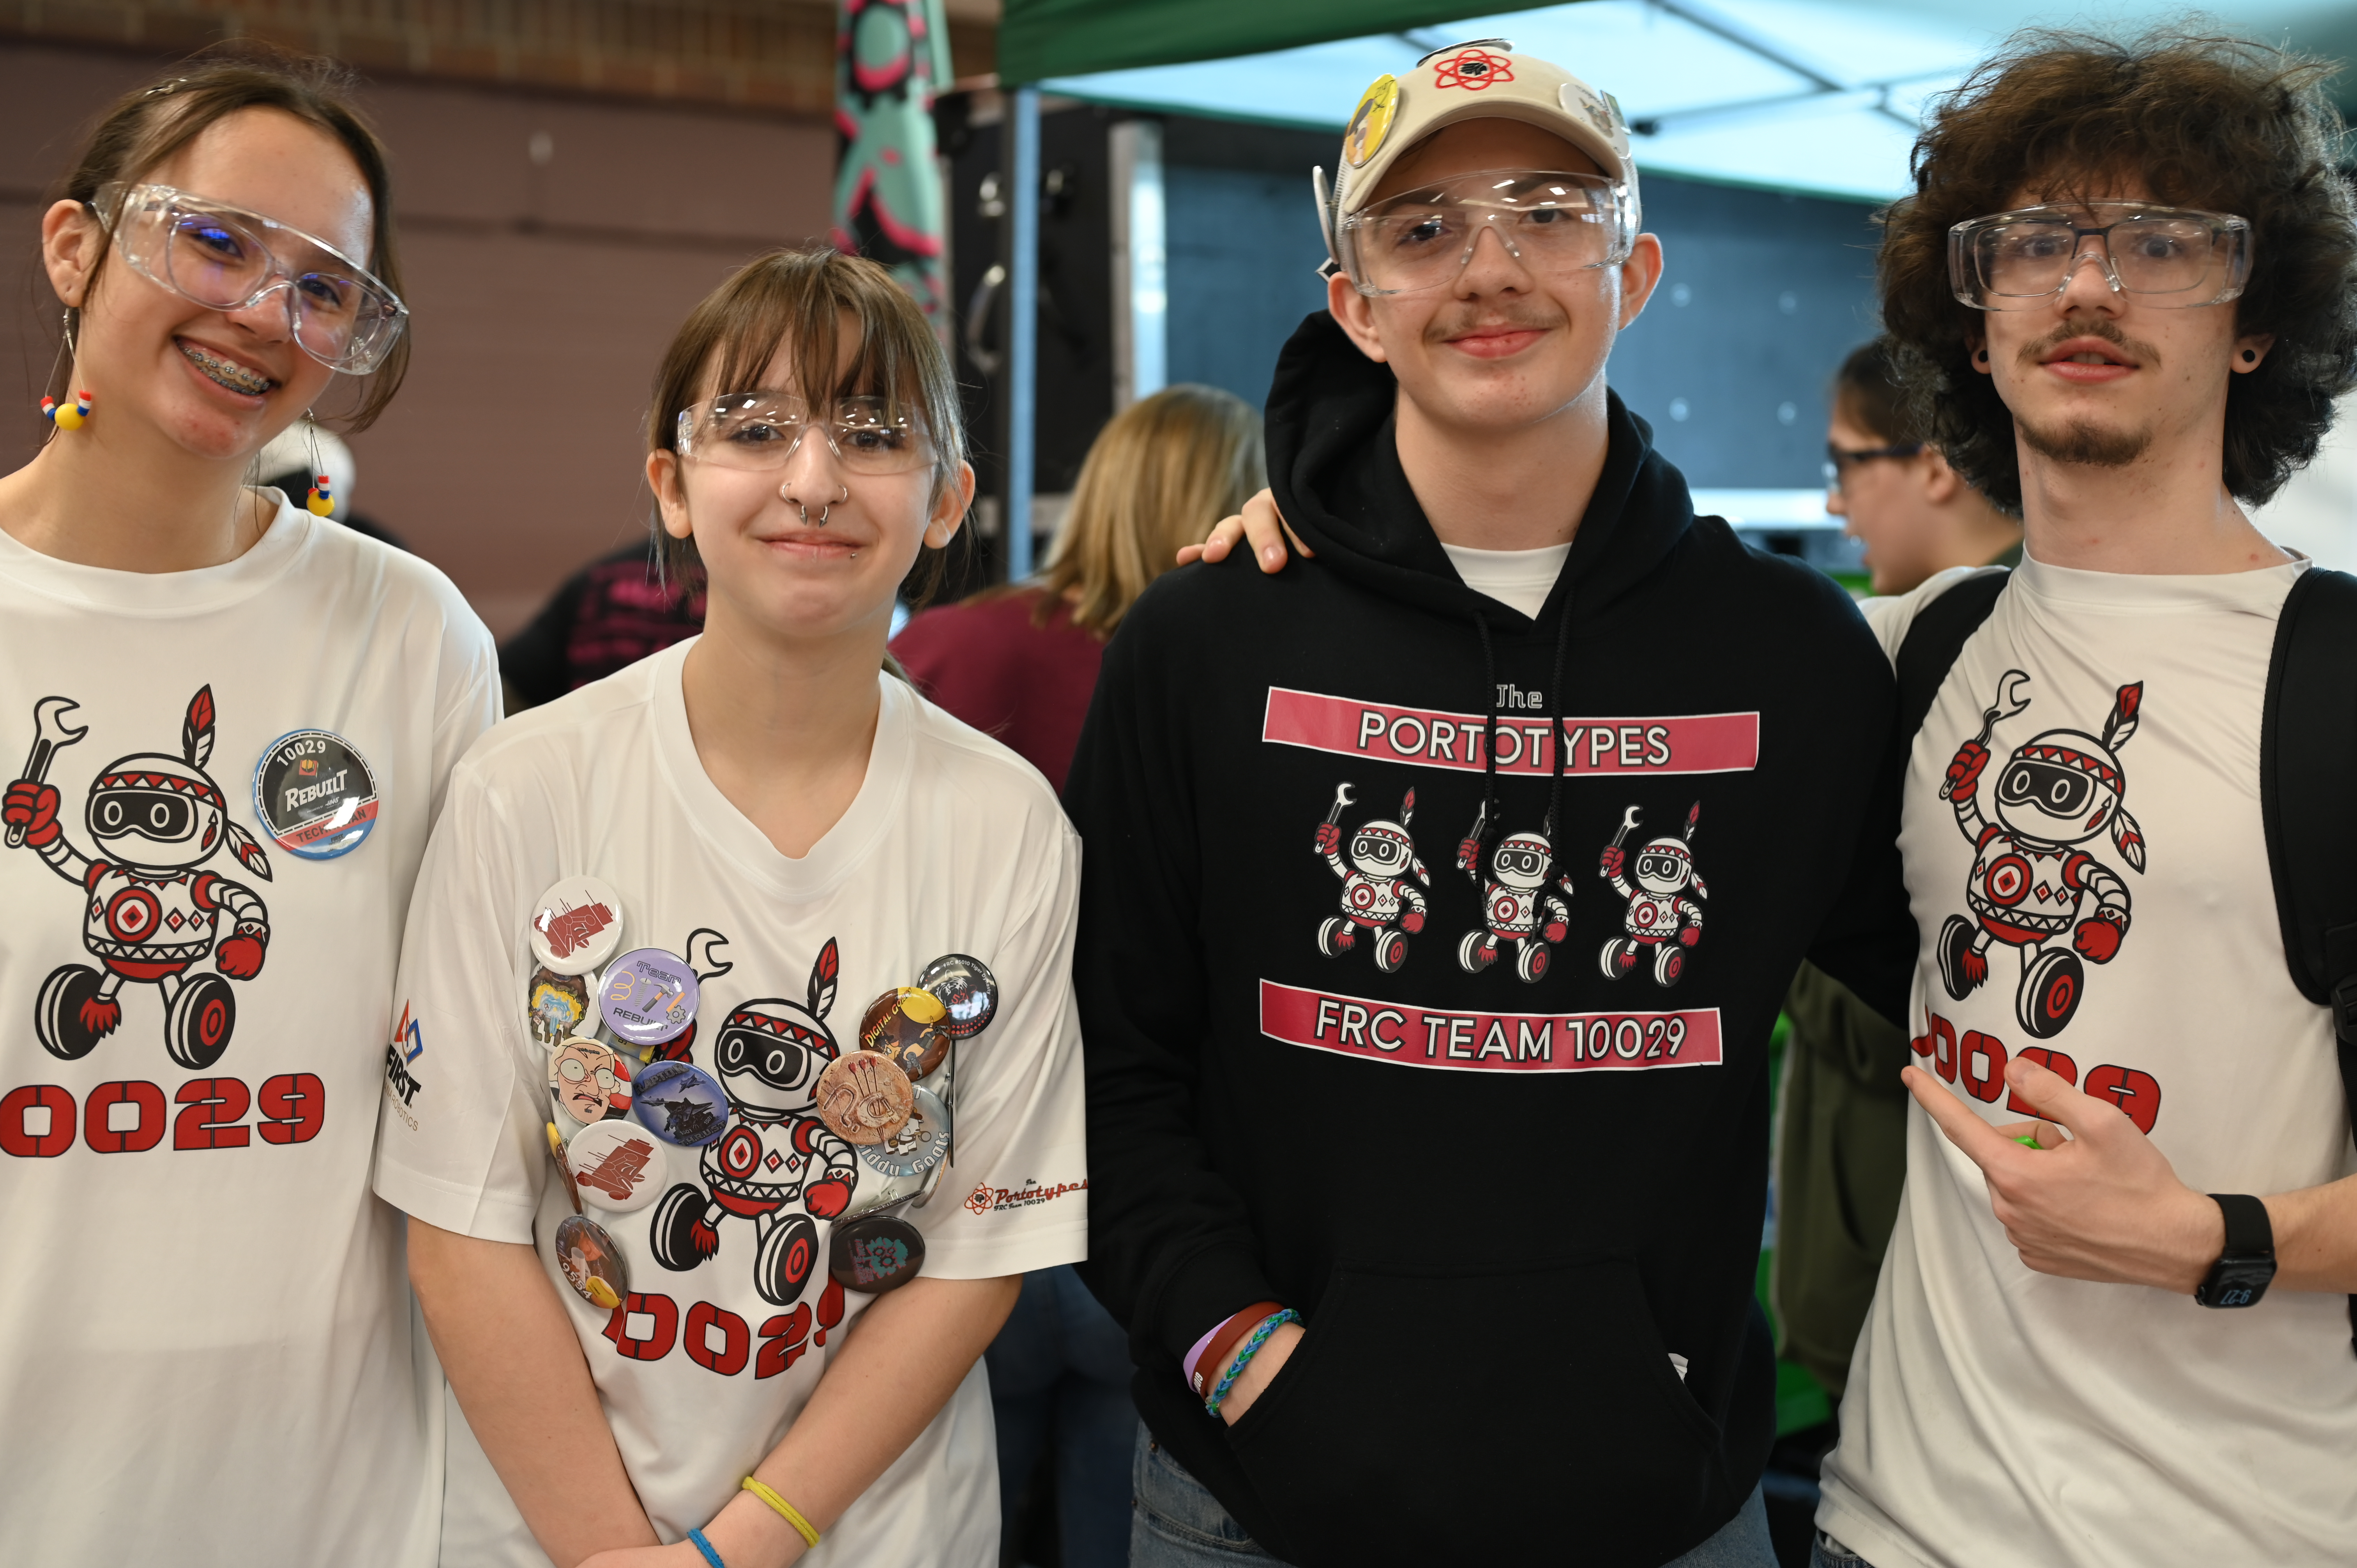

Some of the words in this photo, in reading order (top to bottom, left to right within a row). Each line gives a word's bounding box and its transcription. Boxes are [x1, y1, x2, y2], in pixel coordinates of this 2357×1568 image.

[1496, 683, 1543, 709] The
[277, 740, 326, 766] 10029
[1357, 711, 1671, 767] PORTOTYPES
[285, 769, 348, 812] REBUILT
[296, 809, 367, 843] TECHAN
[636, 961, 682, 985] Team
[971, 963, 982, 974] Tiger
[981, 973, 991, 995] Dynasty
[864, 1012, 891, 1048] DIGITAL
[1313, 997, 1407, 1051] FRC
[1421, 1014, 1553, 1061] TEAM
[1566, 1015, 1687, 1063] 10029
[386, 1044, 422, 1107] FIRST
[391, 1094, 418, 1131] ROBOTICS
[704, 1116, 712, 1125] 1501
[620, 1162, 638, 1176] 71
[912, 1132, 949, 1174] Goats
[995, 1179, 1088, 1204] Portotypes
[1024, 1198, 1045, 1207] 10029
[562, 1262, 592, 1299] 9554
[2220, 1289, 2252, 1305] 9:27
